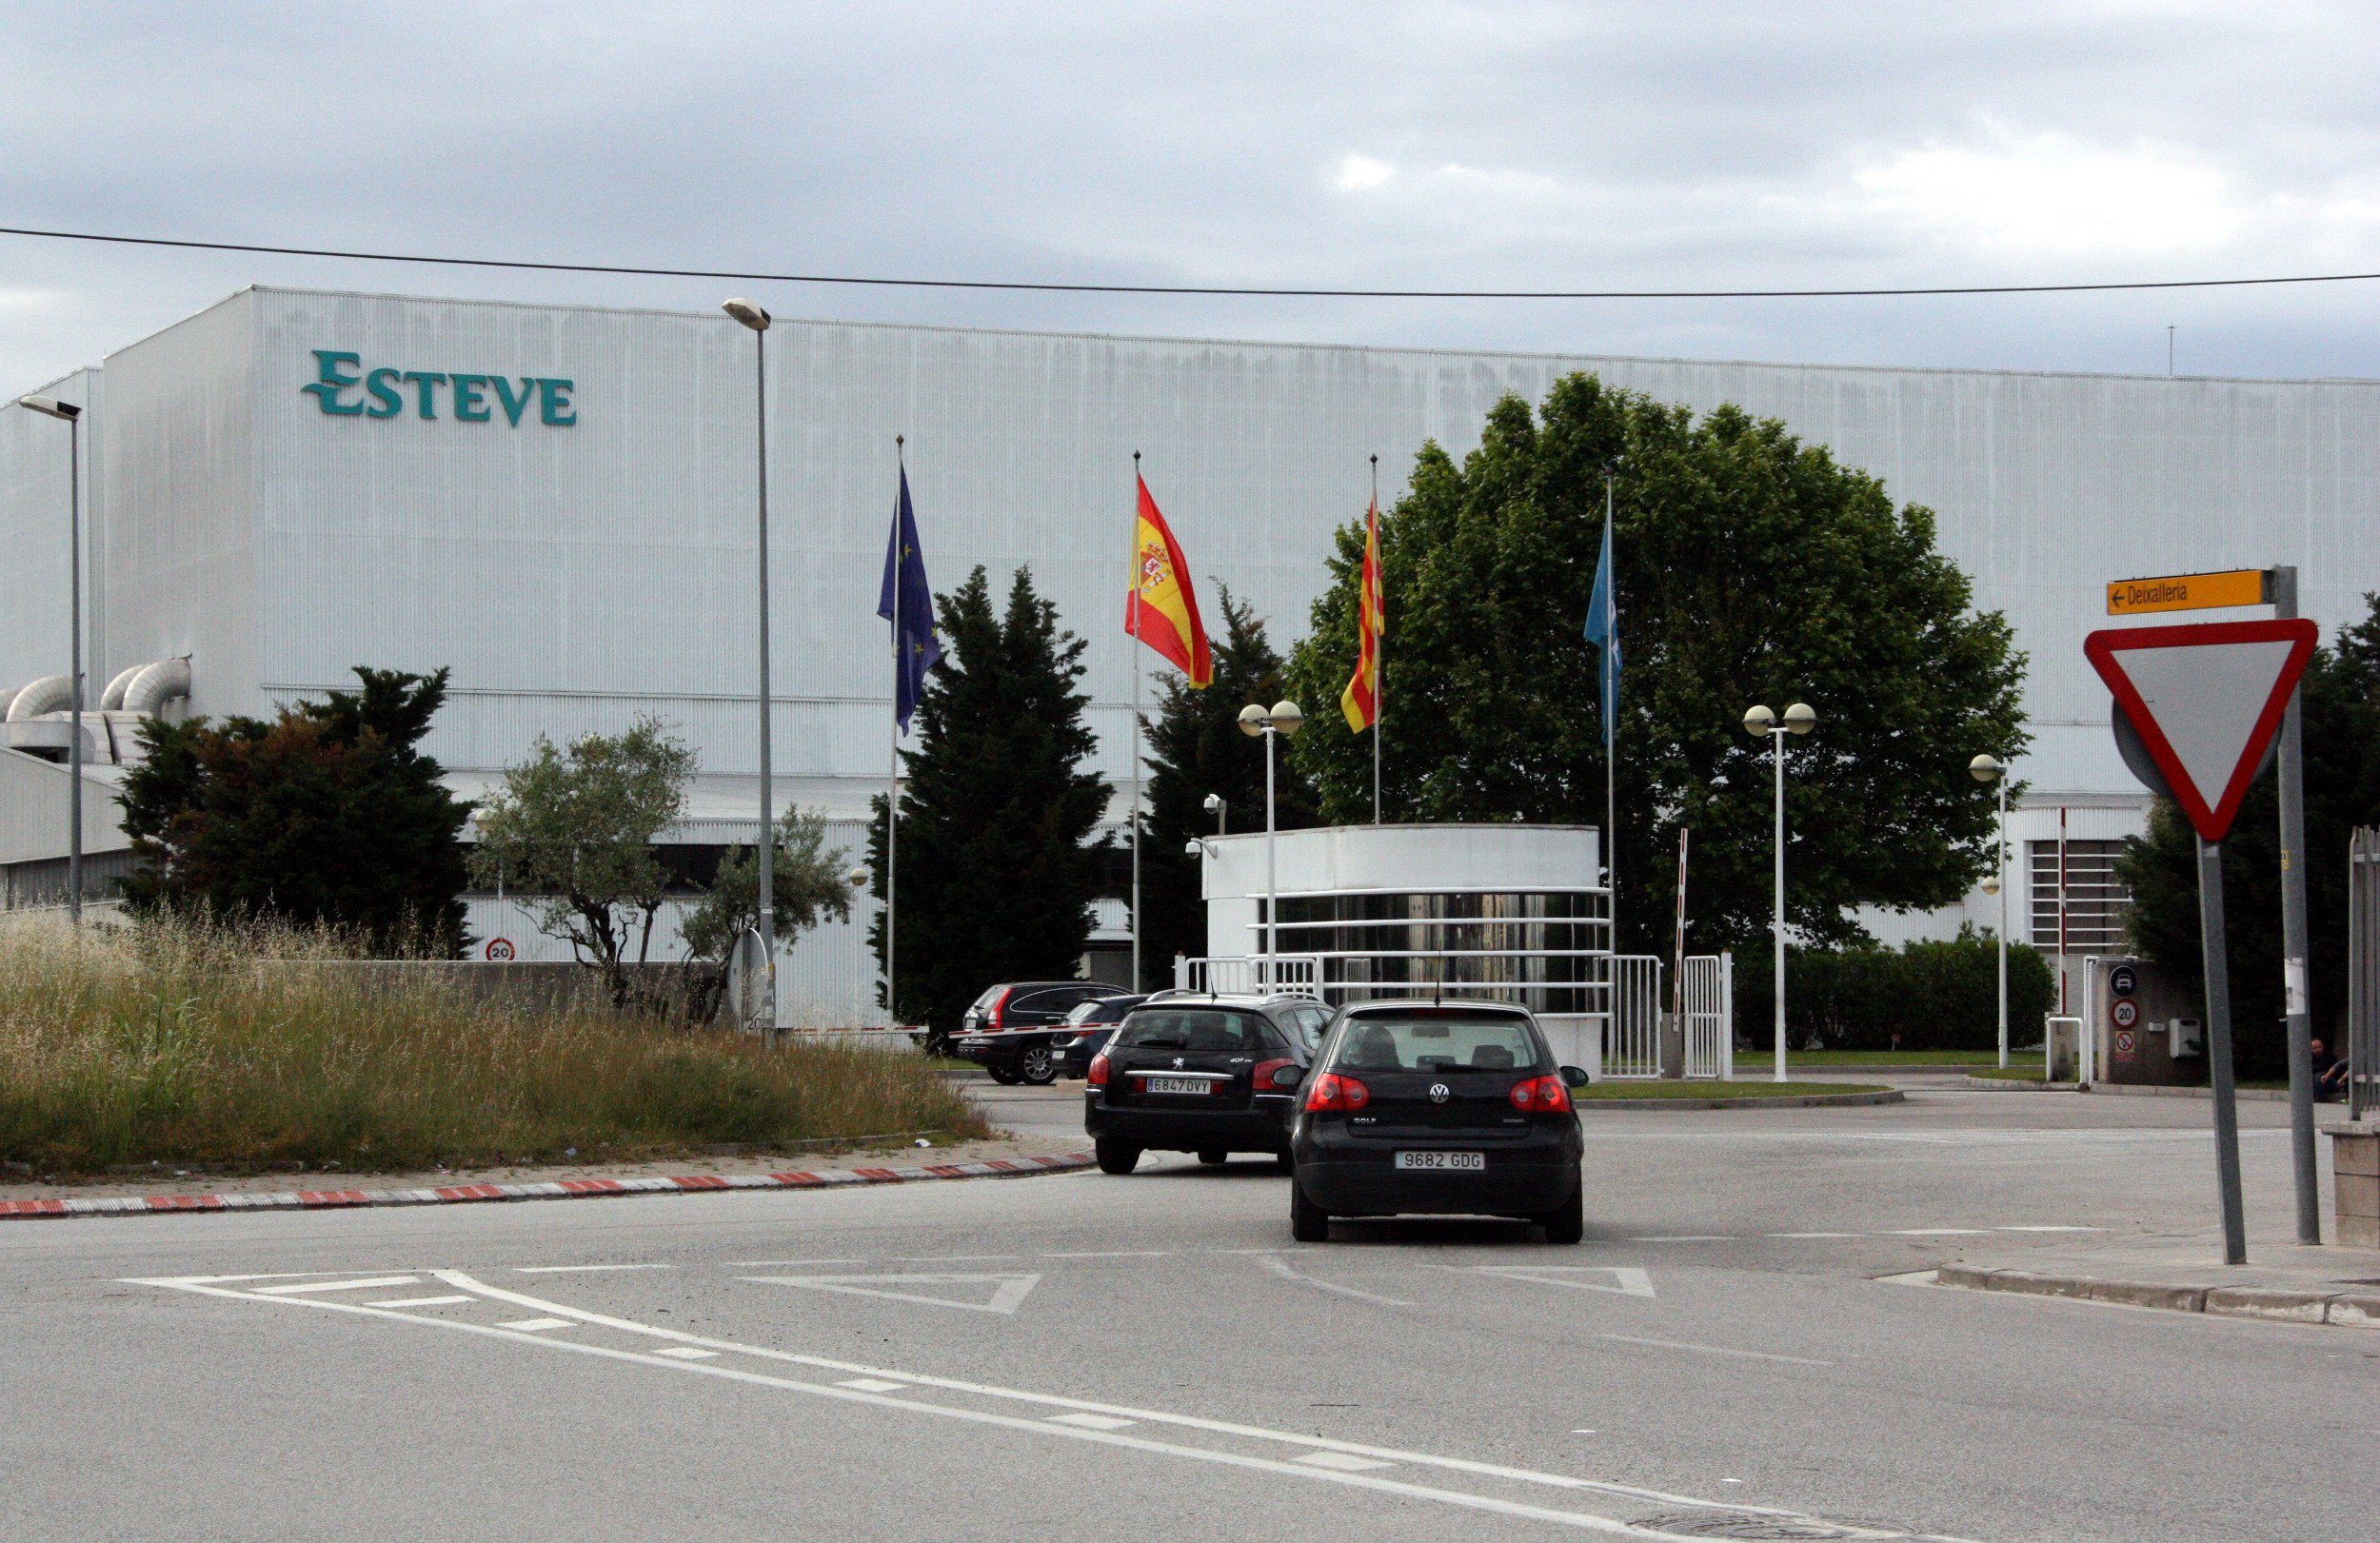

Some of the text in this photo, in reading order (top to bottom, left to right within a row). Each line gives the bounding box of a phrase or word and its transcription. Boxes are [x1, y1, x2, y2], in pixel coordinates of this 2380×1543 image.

[300, 349, 578, 429] ESTEVE
[2128, 582, 2188, 605] Deixalleria
[492, 947, 509, 958] 20
[2119, 1008, 2132, 1019] 20
[1404, 1153, 1480, 1168] 9682 GDG
